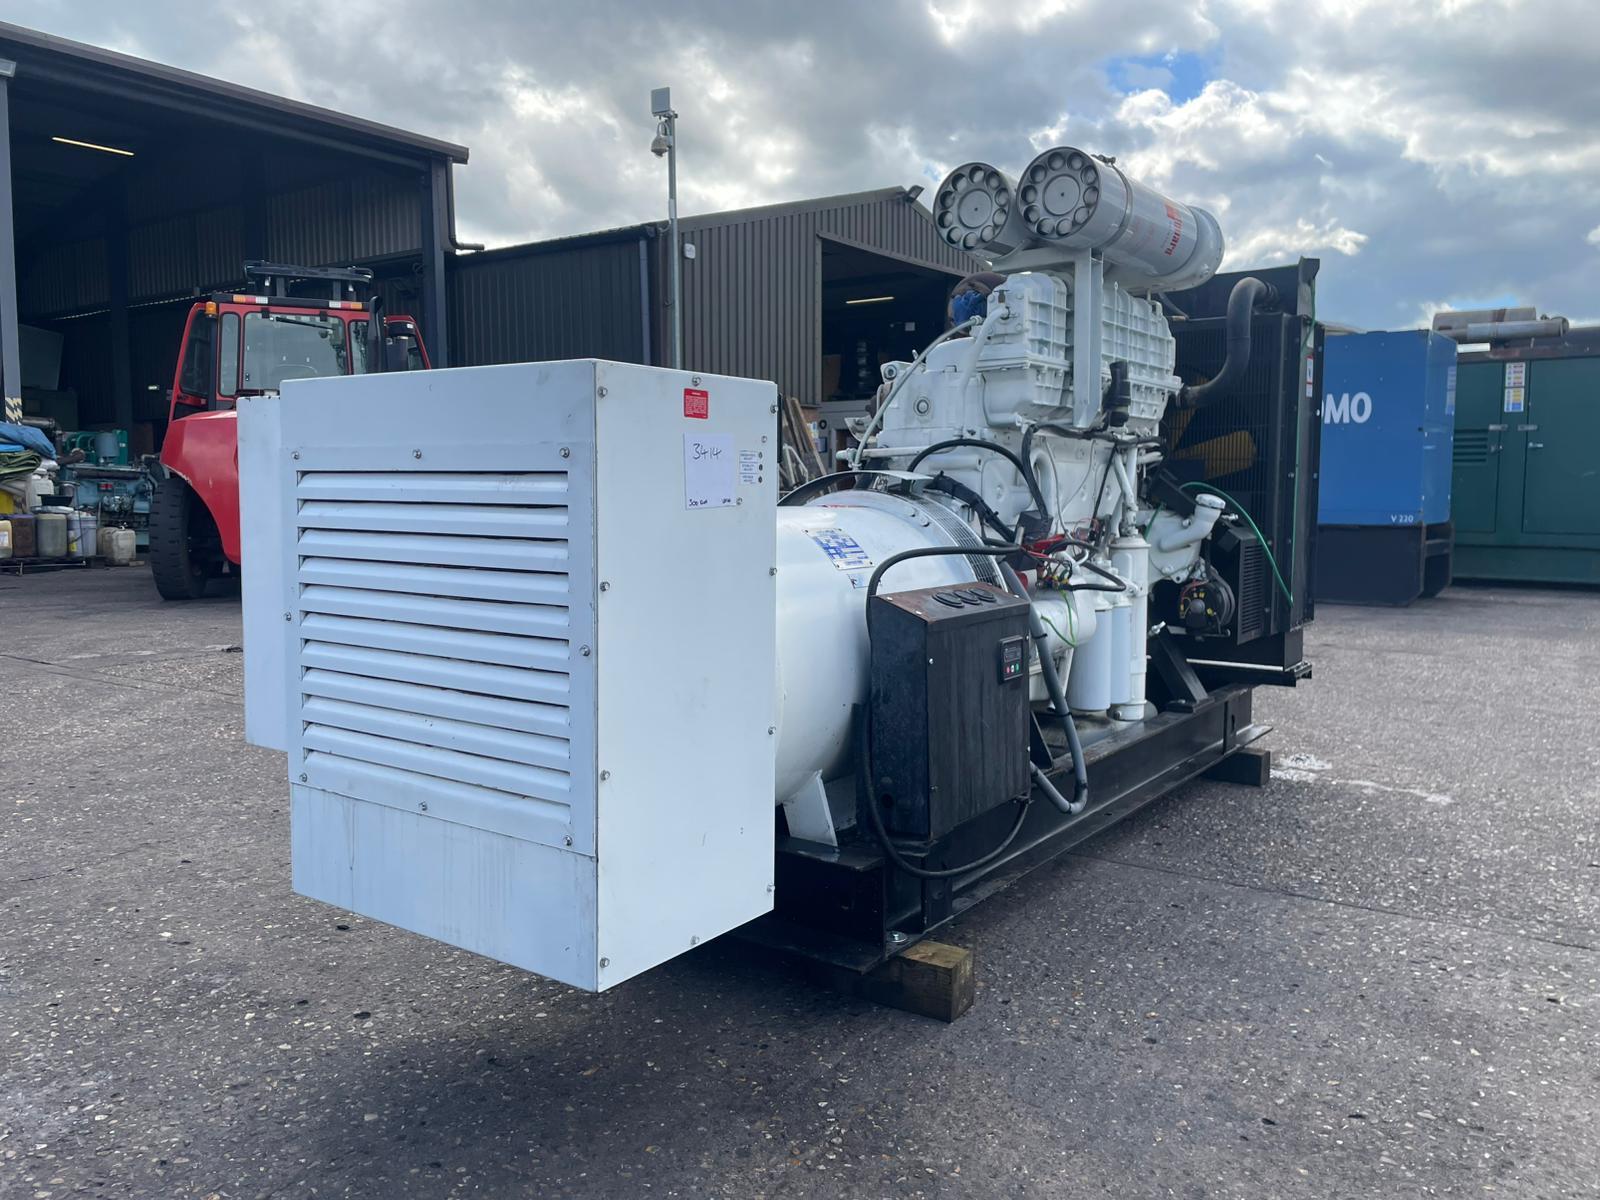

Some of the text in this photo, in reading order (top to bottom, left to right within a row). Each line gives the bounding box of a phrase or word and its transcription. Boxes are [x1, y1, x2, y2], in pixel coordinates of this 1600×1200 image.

[1321, 391, 1372, 424] MO
[693, 443, 722, 460] 3414
[1390, 514, 1414, 523] V 220
